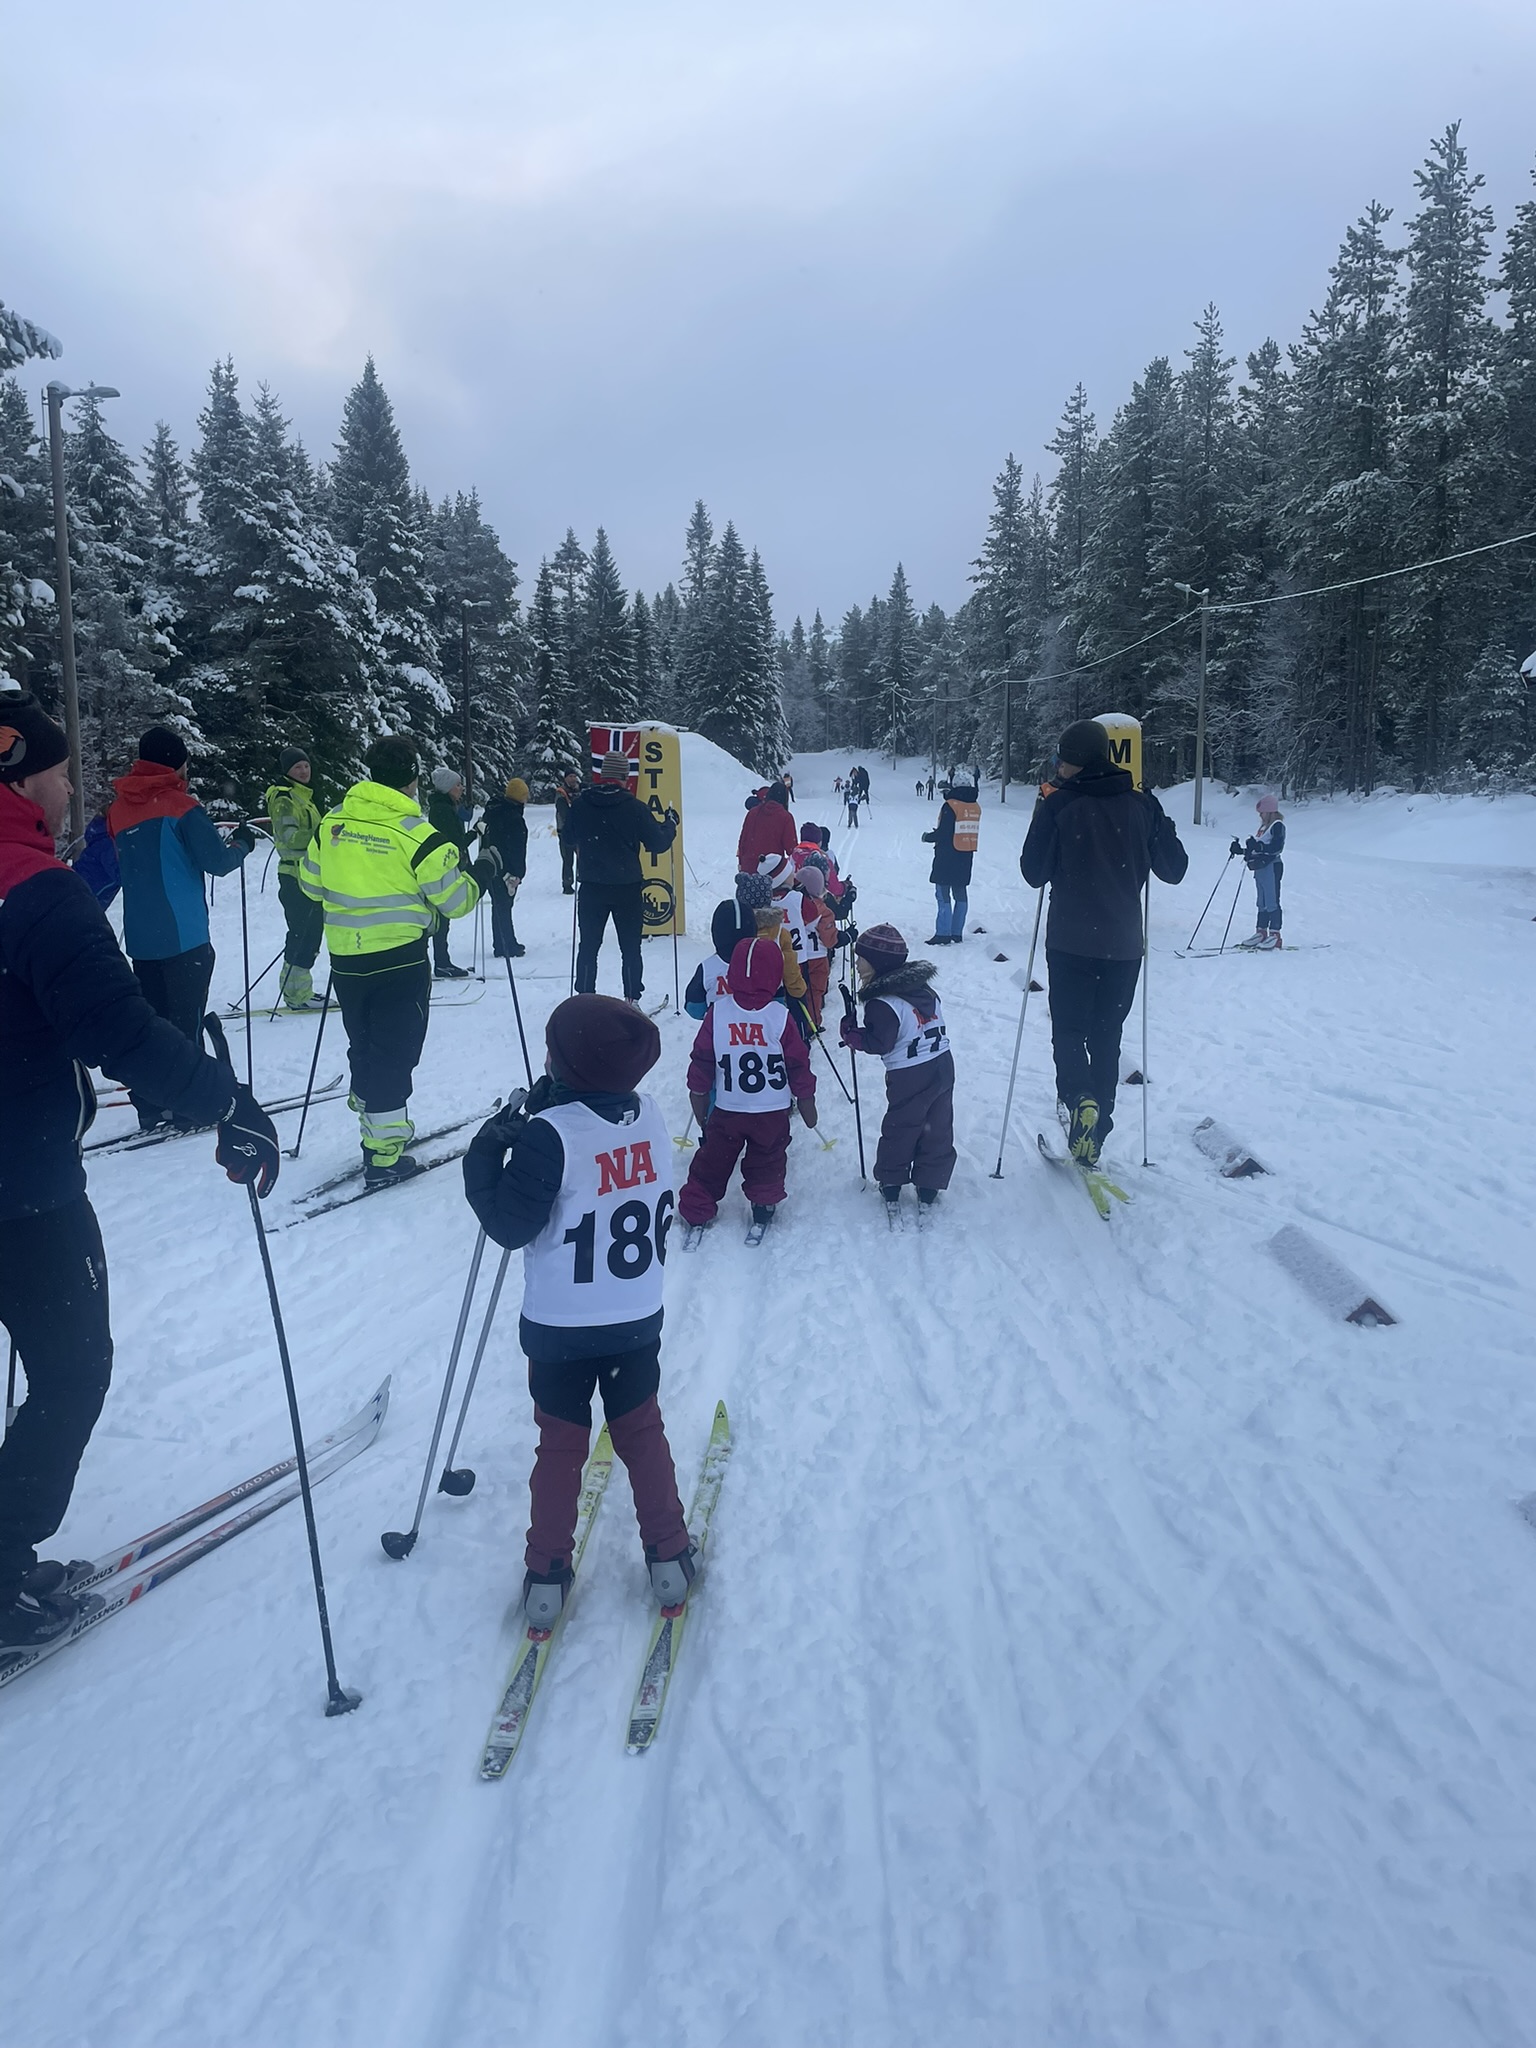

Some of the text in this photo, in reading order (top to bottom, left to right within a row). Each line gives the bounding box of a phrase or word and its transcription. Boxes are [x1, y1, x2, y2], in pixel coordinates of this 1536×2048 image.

[644, 741, 666, 867] STAT
[728, 1022, 768, 1047] NA
[717, 1051, 788, 1094] 185
[594, 1140, 658, 1197] NA
[562, 1189, 675, 1284] 186
[70, 1597, 125, 1638] MADSHUS
